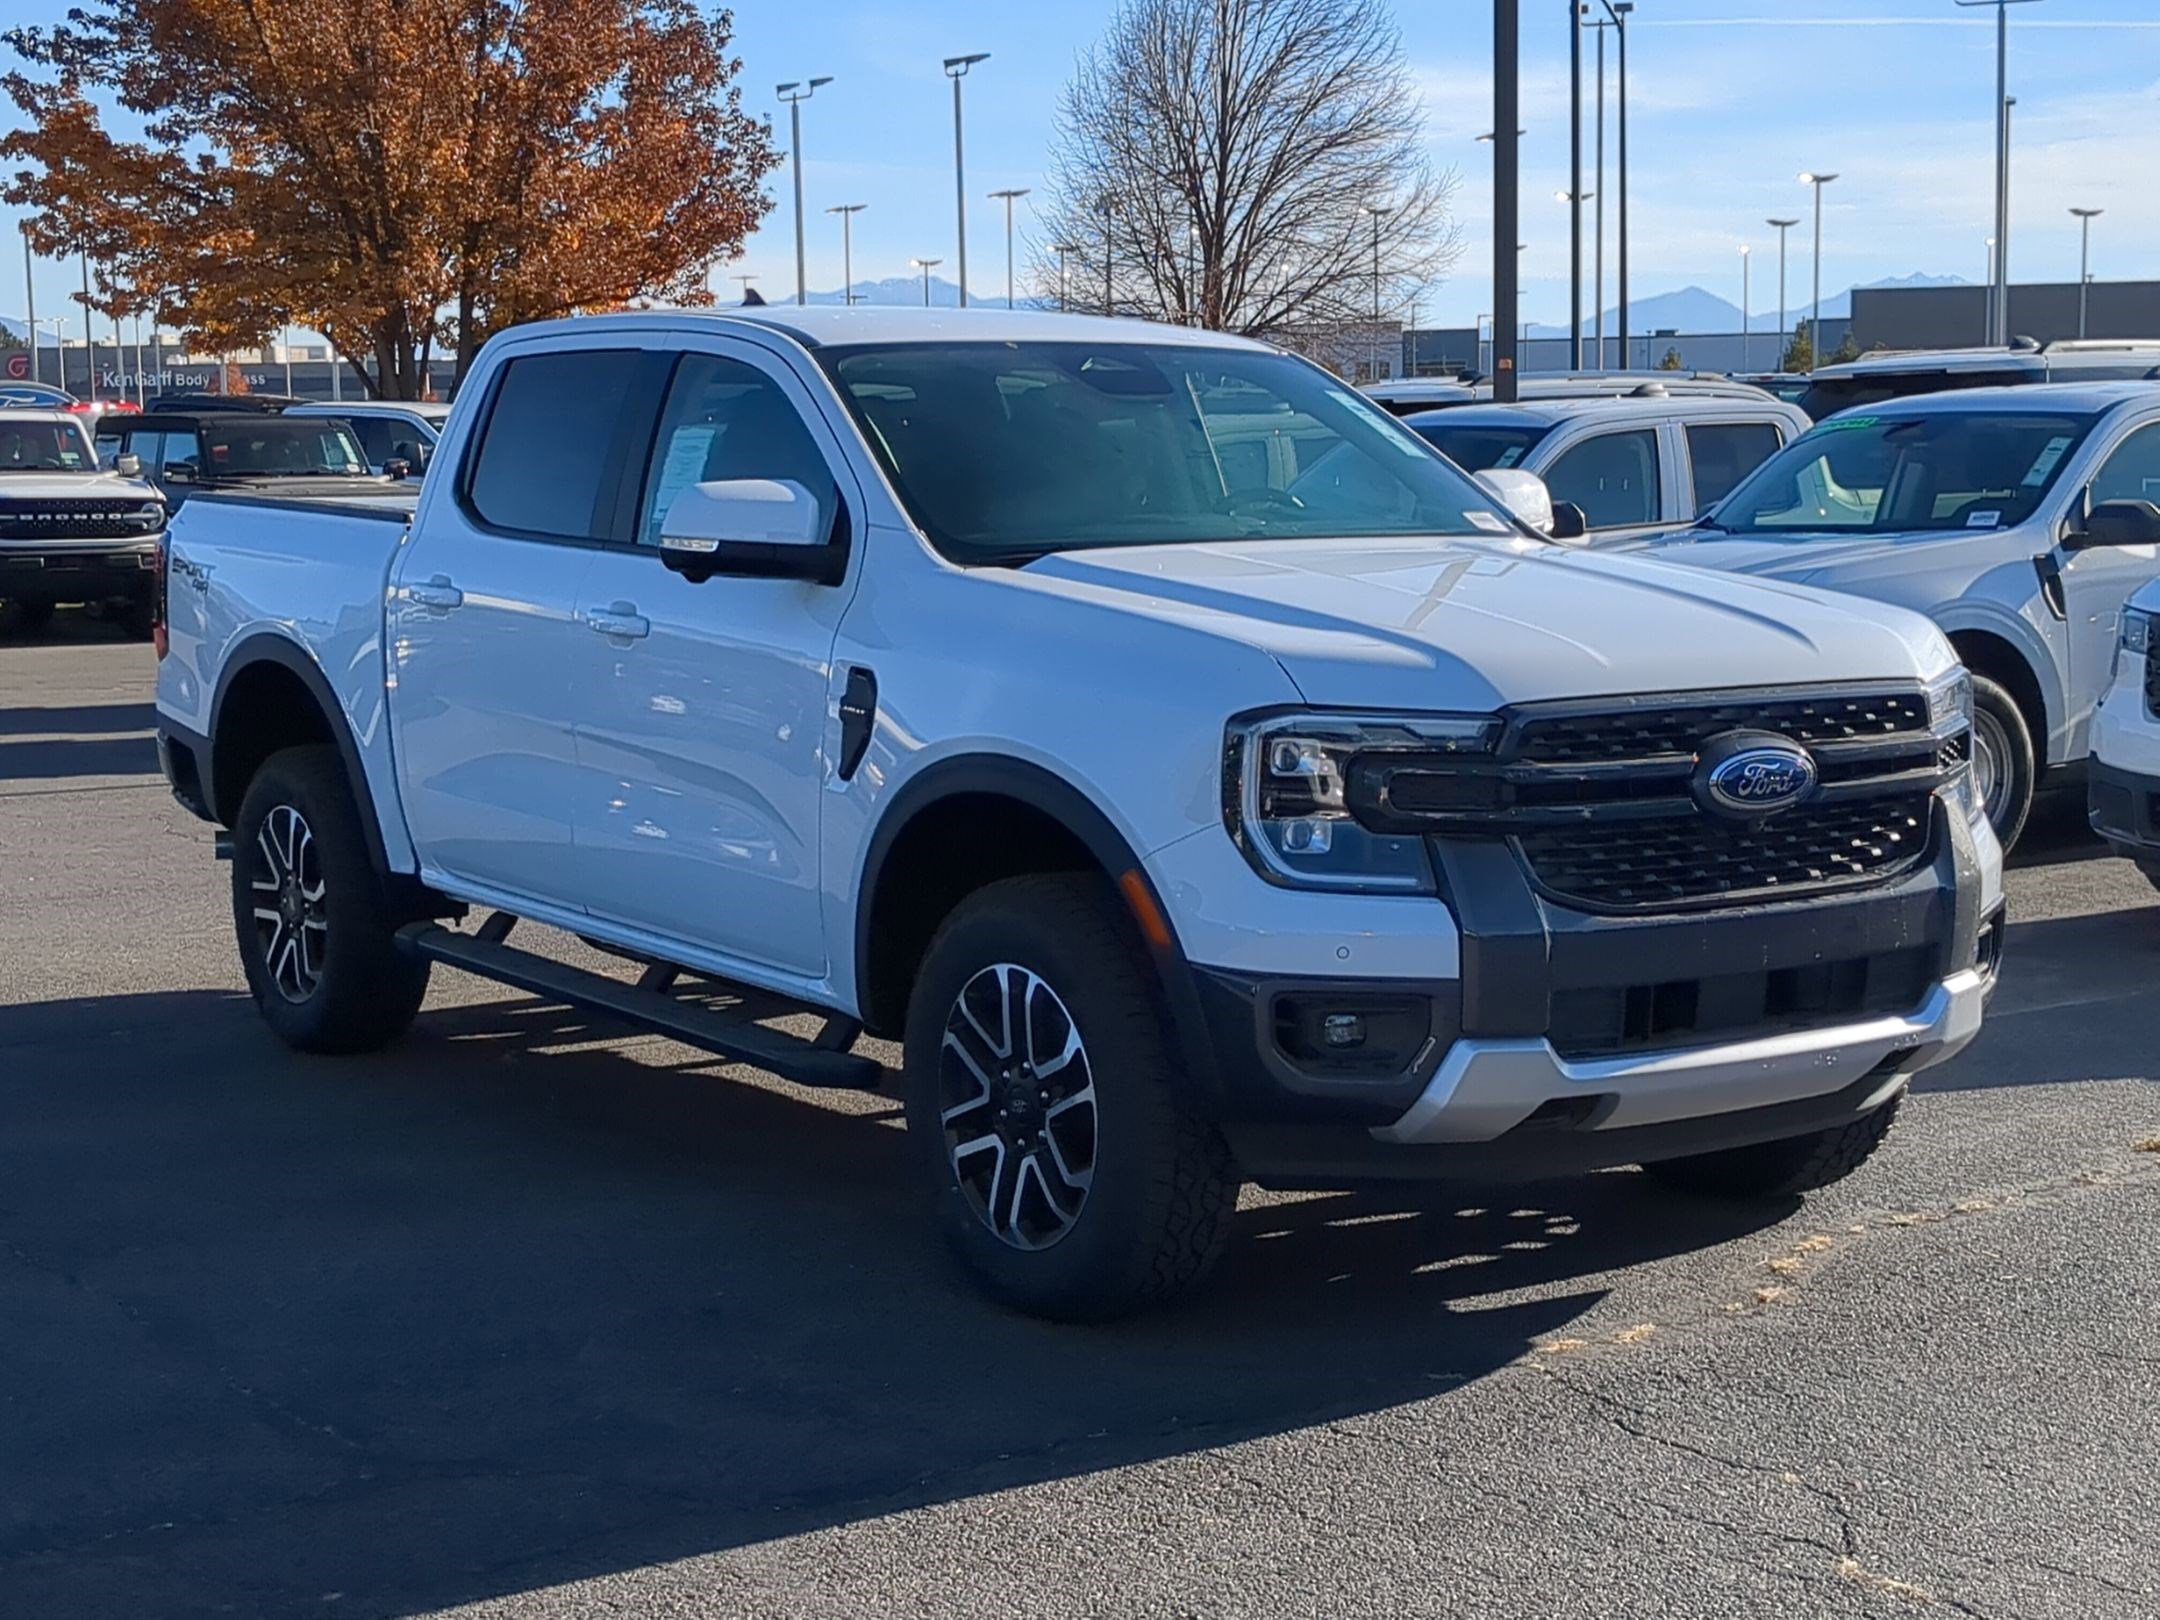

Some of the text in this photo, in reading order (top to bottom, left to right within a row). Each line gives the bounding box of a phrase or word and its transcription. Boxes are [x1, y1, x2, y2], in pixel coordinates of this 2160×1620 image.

[175, 373, 210, 389] Body
[19, 513, 122, 521] BRONCO
[1738, 763, 1794, 796] Ford
